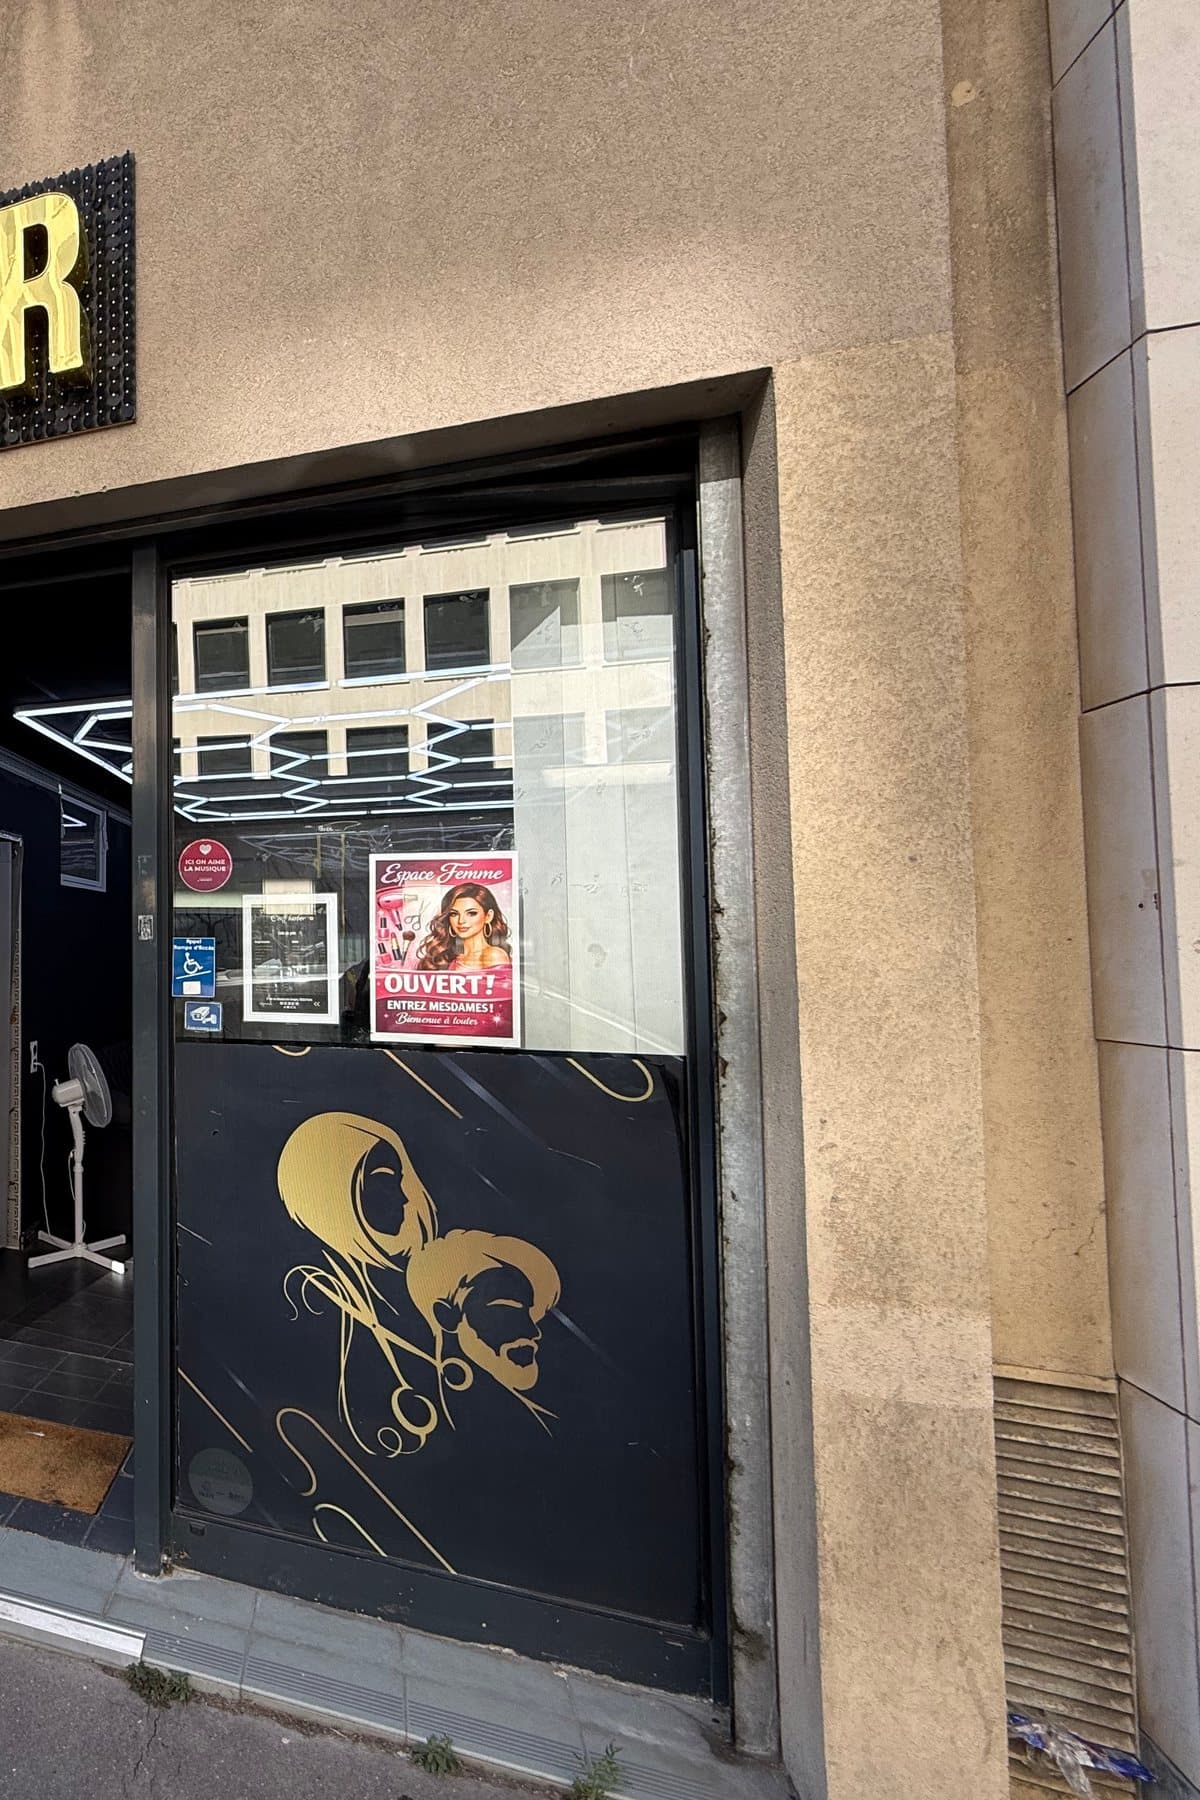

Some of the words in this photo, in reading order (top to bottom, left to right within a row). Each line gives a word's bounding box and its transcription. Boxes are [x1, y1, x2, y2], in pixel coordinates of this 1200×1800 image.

[194, 865, 227, 873] MUSIQUE
[380, 863, 436, 887] Espace
[436, 862, 504, 884] Femme
[387, 1000, 427, 1011] ENTREZ
[395, 1012, 442, 1025] Bienvenue
[443, 1016, 451, 1025] à
[452, 1016, 478, 1026] toutes
